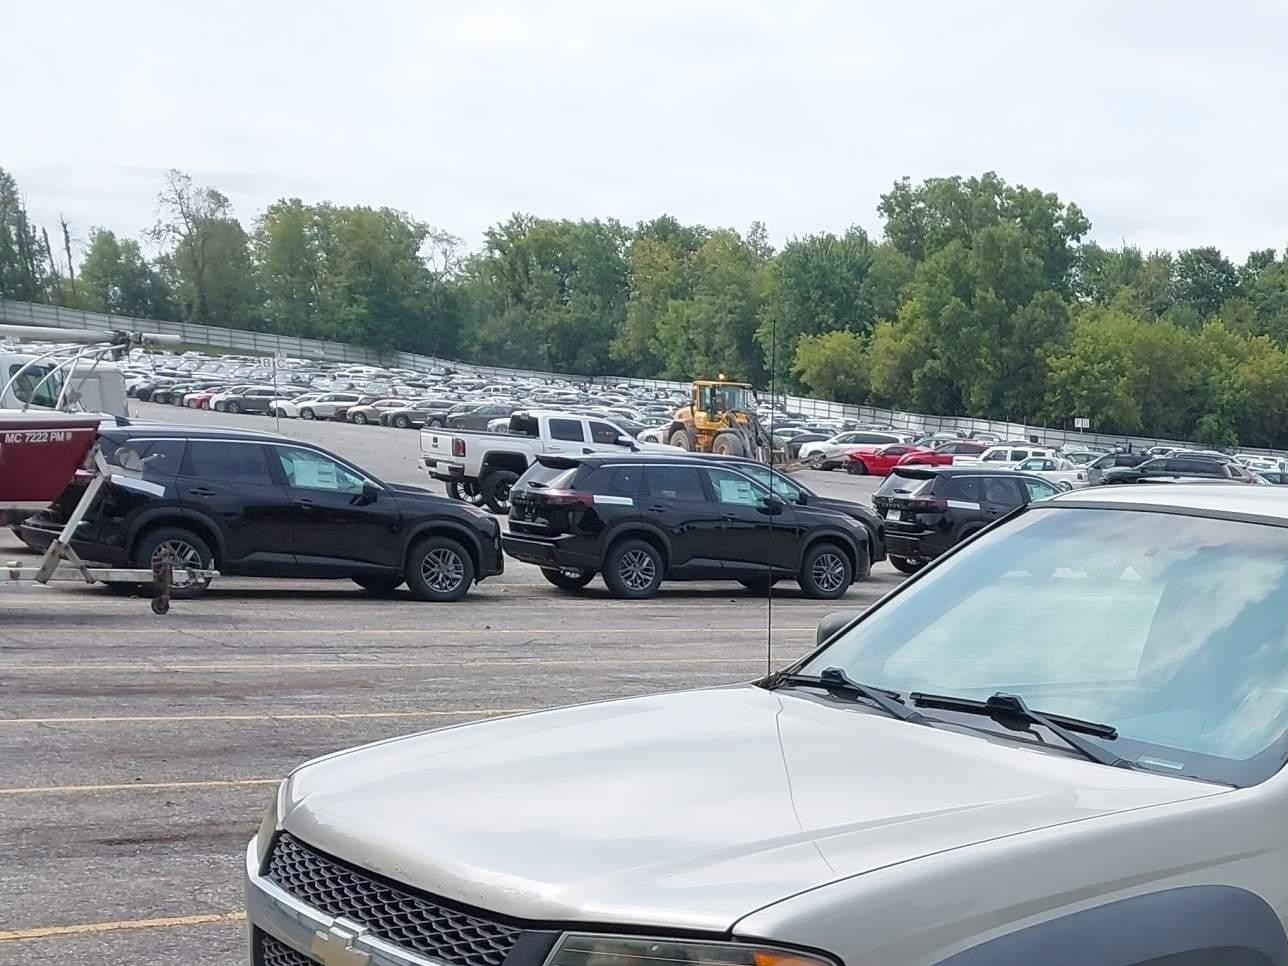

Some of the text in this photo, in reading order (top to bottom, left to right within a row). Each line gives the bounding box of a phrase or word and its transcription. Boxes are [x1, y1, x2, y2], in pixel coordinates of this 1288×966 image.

[5, 432, 23, 444] MC
[25, 431, 49, 443] 7222
[50, 431, 65, 443] PM
